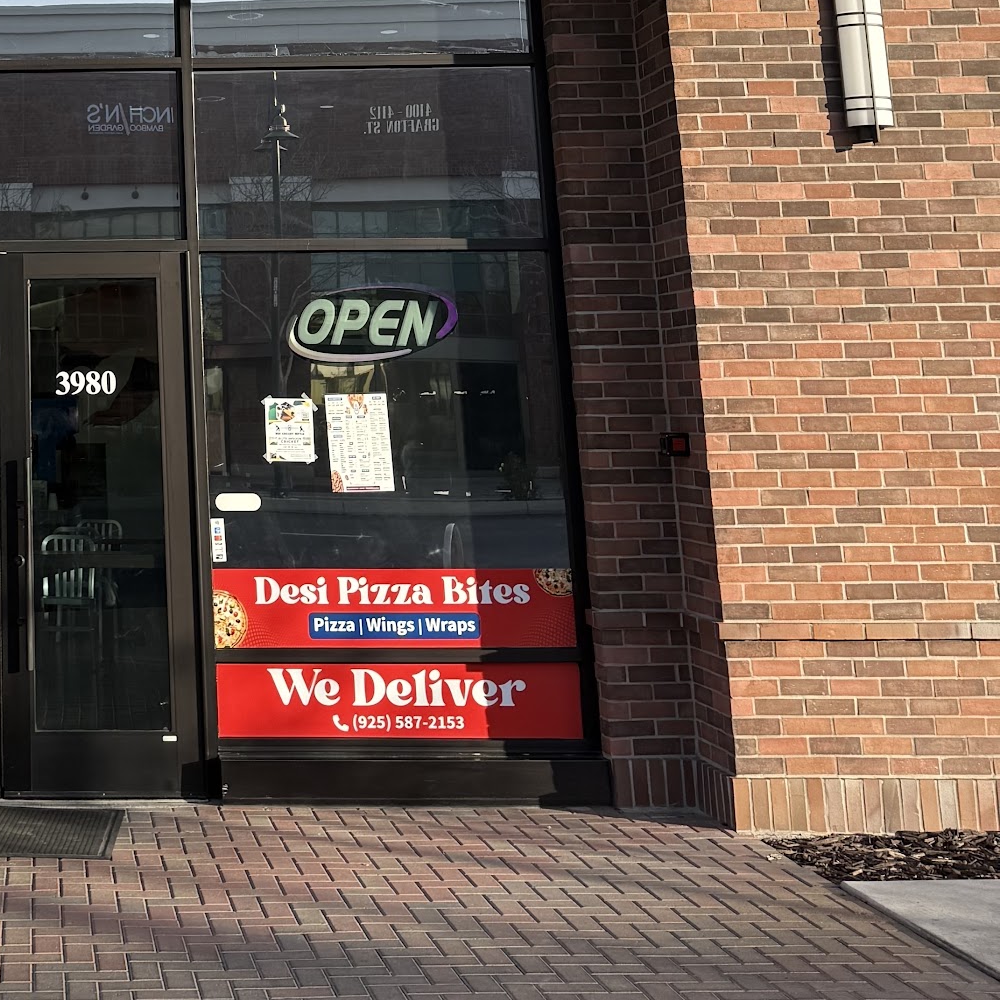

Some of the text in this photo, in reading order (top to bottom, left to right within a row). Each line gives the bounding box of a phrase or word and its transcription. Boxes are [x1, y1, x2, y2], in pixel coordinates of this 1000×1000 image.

[297, 298, 439, 347] OPEN
[55, 370, 117, 396] 3980
[253, 575, 531, 605] Desi Pizza Bites
[313, 616, 356, 633] Pizza
[365, 616, 416, 636] Wings
[424, 617, 476, 637] Wraps
[266, 667, 526, 707] We Deliver
[352, 713, 465, 732] (925) 587-2153
